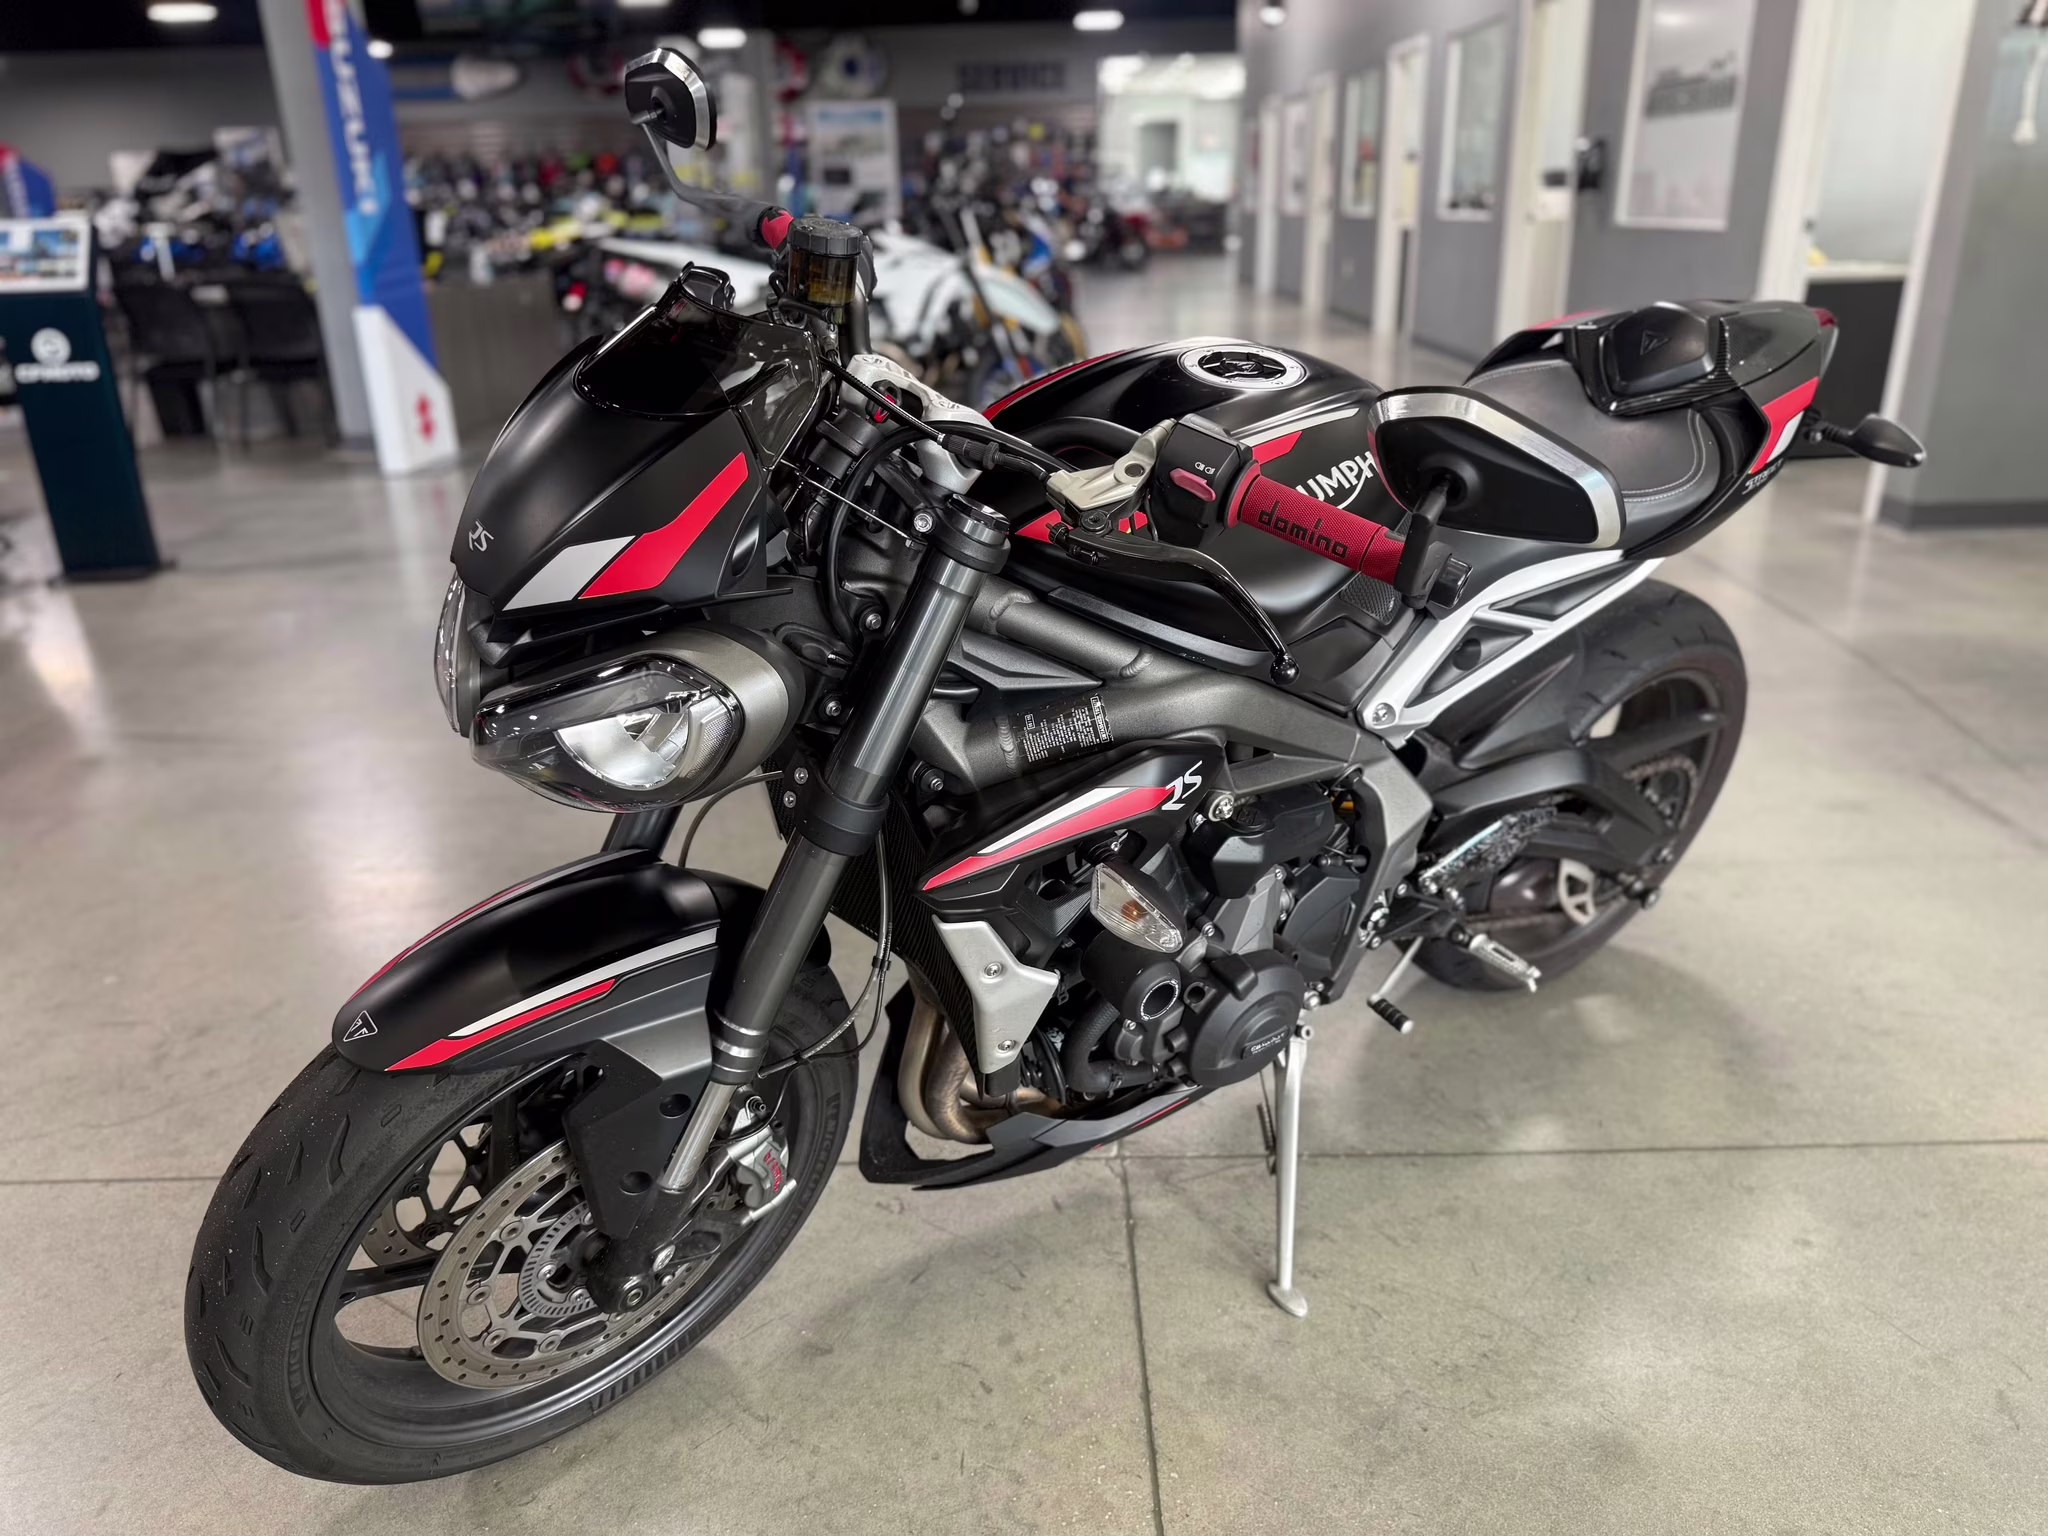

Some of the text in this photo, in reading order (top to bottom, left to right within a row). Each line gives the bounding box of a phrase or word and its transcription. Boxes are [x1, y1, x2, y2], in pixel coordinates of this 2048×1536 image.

[1295, 450, 1379, 502] UMPH
[468, 518, 494, 552] RS
[1257, 500, 1348, 559] domino
[1161, 760, 1203, 811] RS
